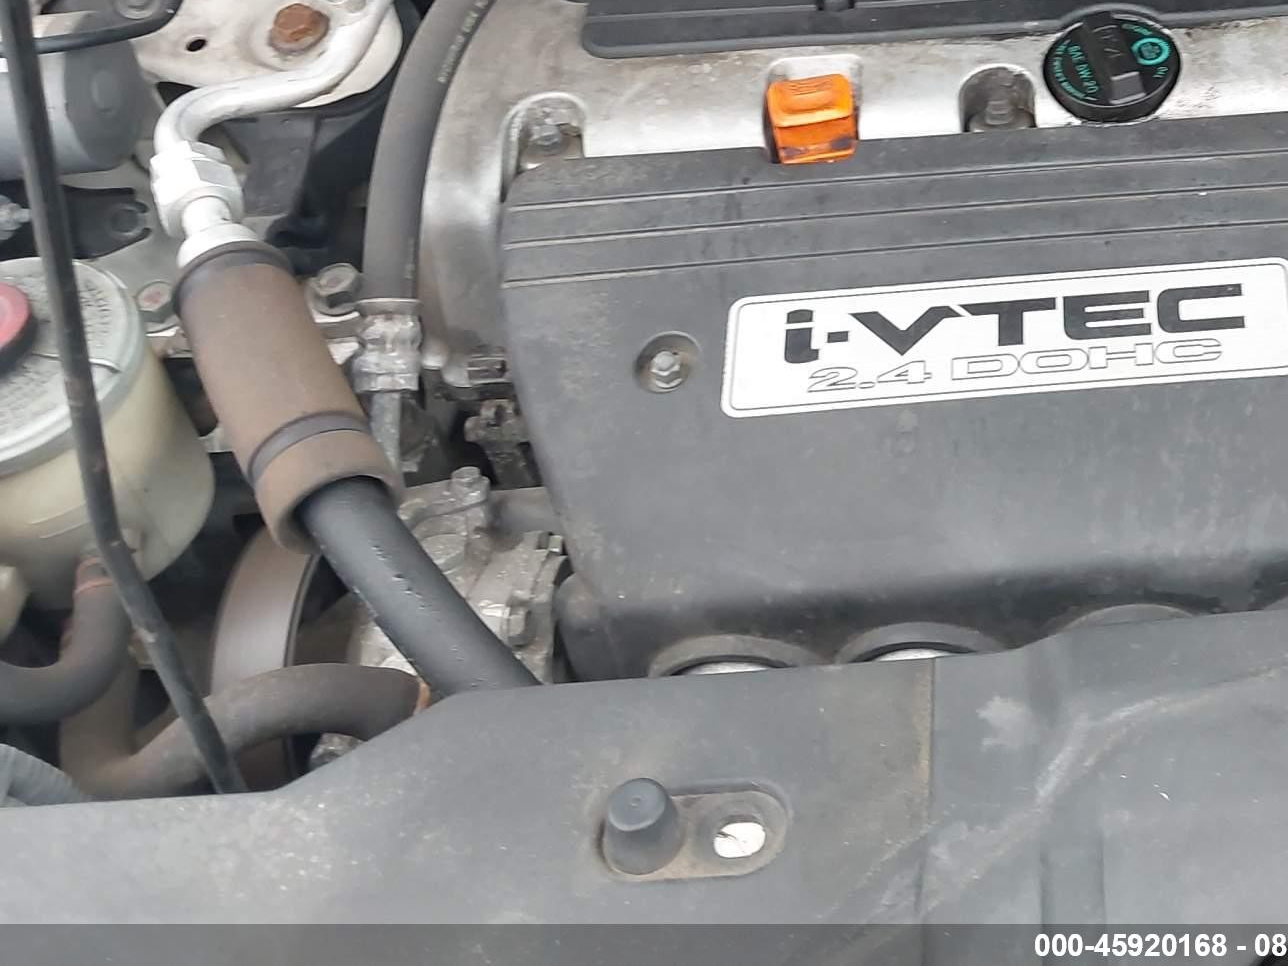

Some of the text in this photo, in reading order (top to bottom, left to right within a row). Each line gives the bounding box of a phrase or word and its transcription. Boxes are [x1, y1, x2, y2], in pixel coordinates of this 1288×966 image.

[784, 282, 1246, 365] i-VTEC
[806, 337, 1223, 393] 2.4 DOHC
